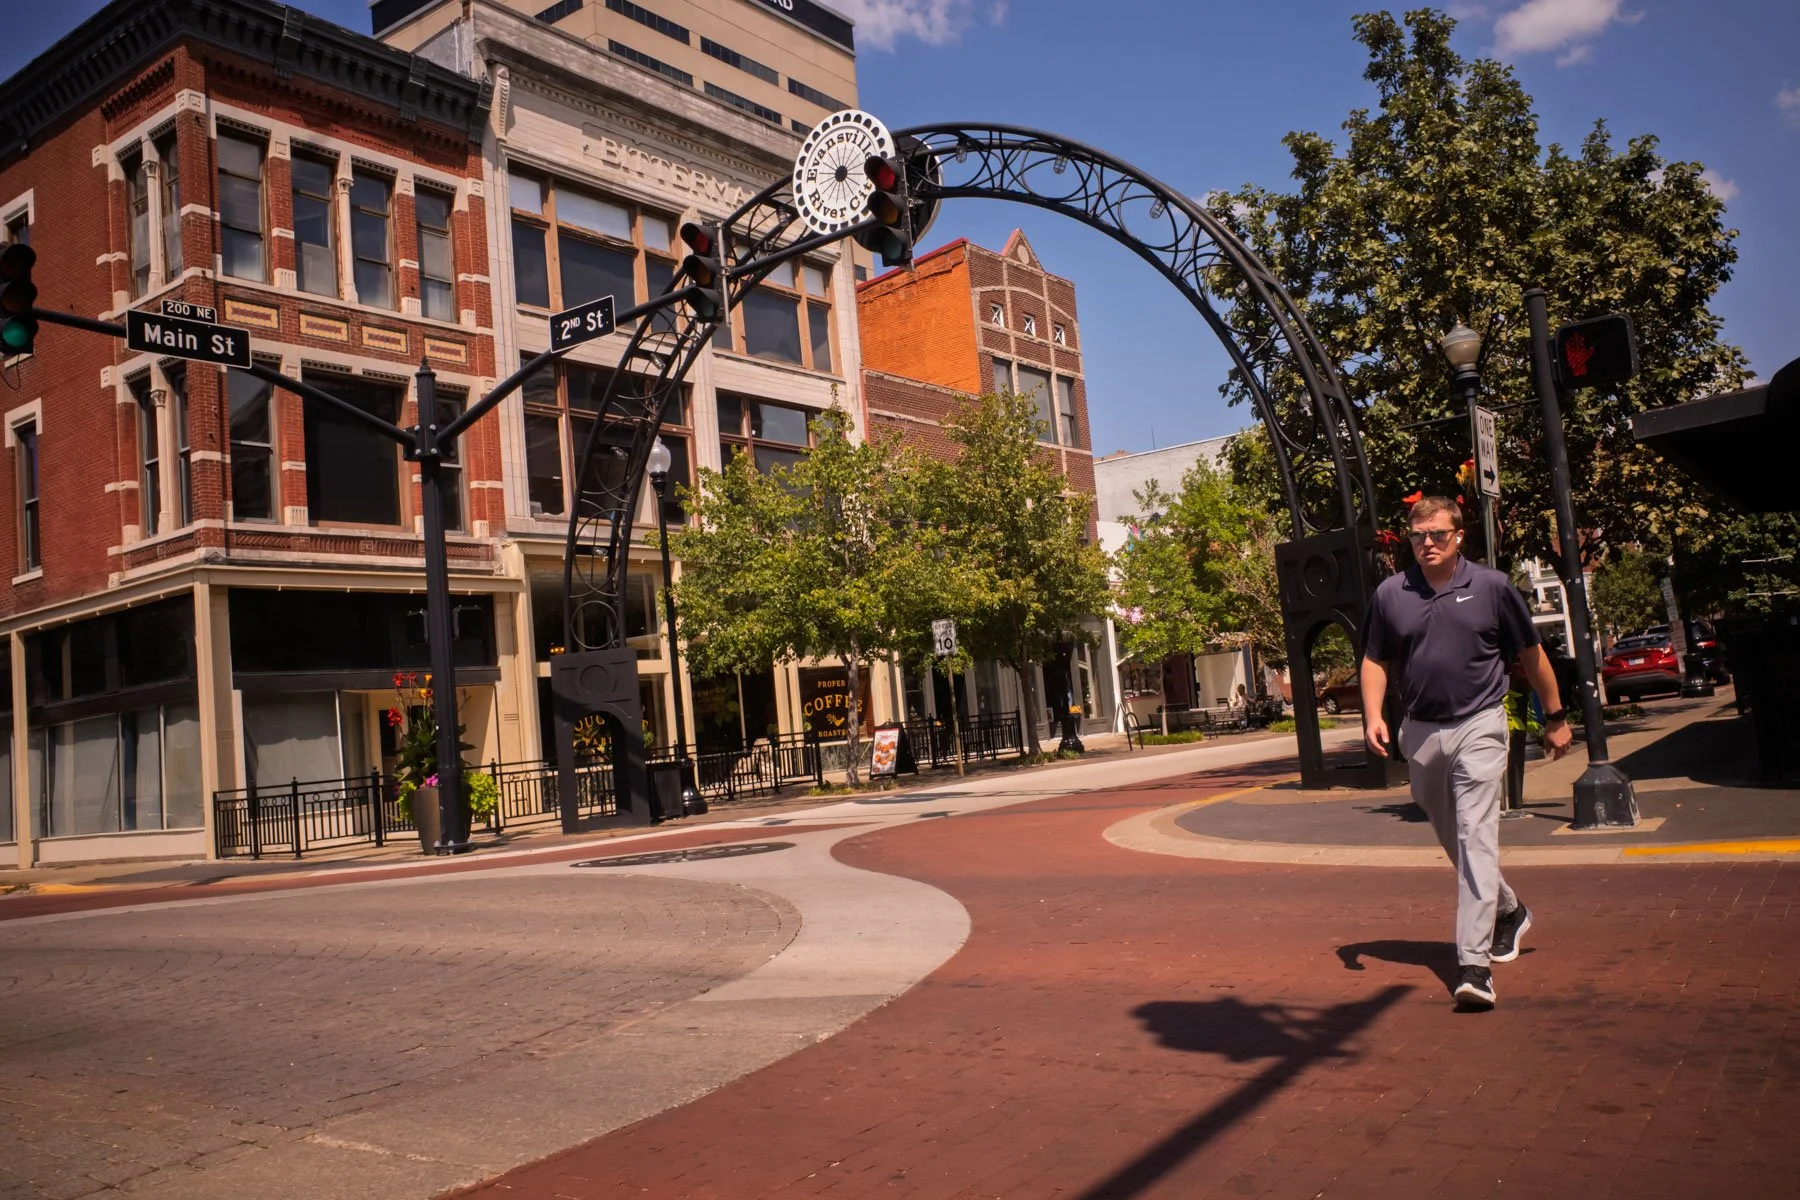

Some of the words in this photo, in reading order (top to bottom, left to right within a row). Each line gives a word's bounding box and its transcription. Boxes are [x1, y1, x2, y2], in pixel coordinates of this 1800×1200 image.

[806, 130, 873, 184] Evansville
[600, 136, 756, 208] BITTERMA
[808, 188, 847, 219] River
[849, 177, 873, 211] Cit
[166, 302, 191, 316] 200
[197, 307, 212, 320] NE
[561, 316, 581, 341] 2ND
[586, 309, 604, 332] St
[144, 322, 198, 351] Main
[211, 334, 235, 356] St
[1480, 415, 1493, 438] ONE
[1481, 439, 1495, 461] WAY
[939, 637, 953, 651] 10
[817, 680, 846, 688] PROPER
[818, 729, 849, 738] ROASTE
